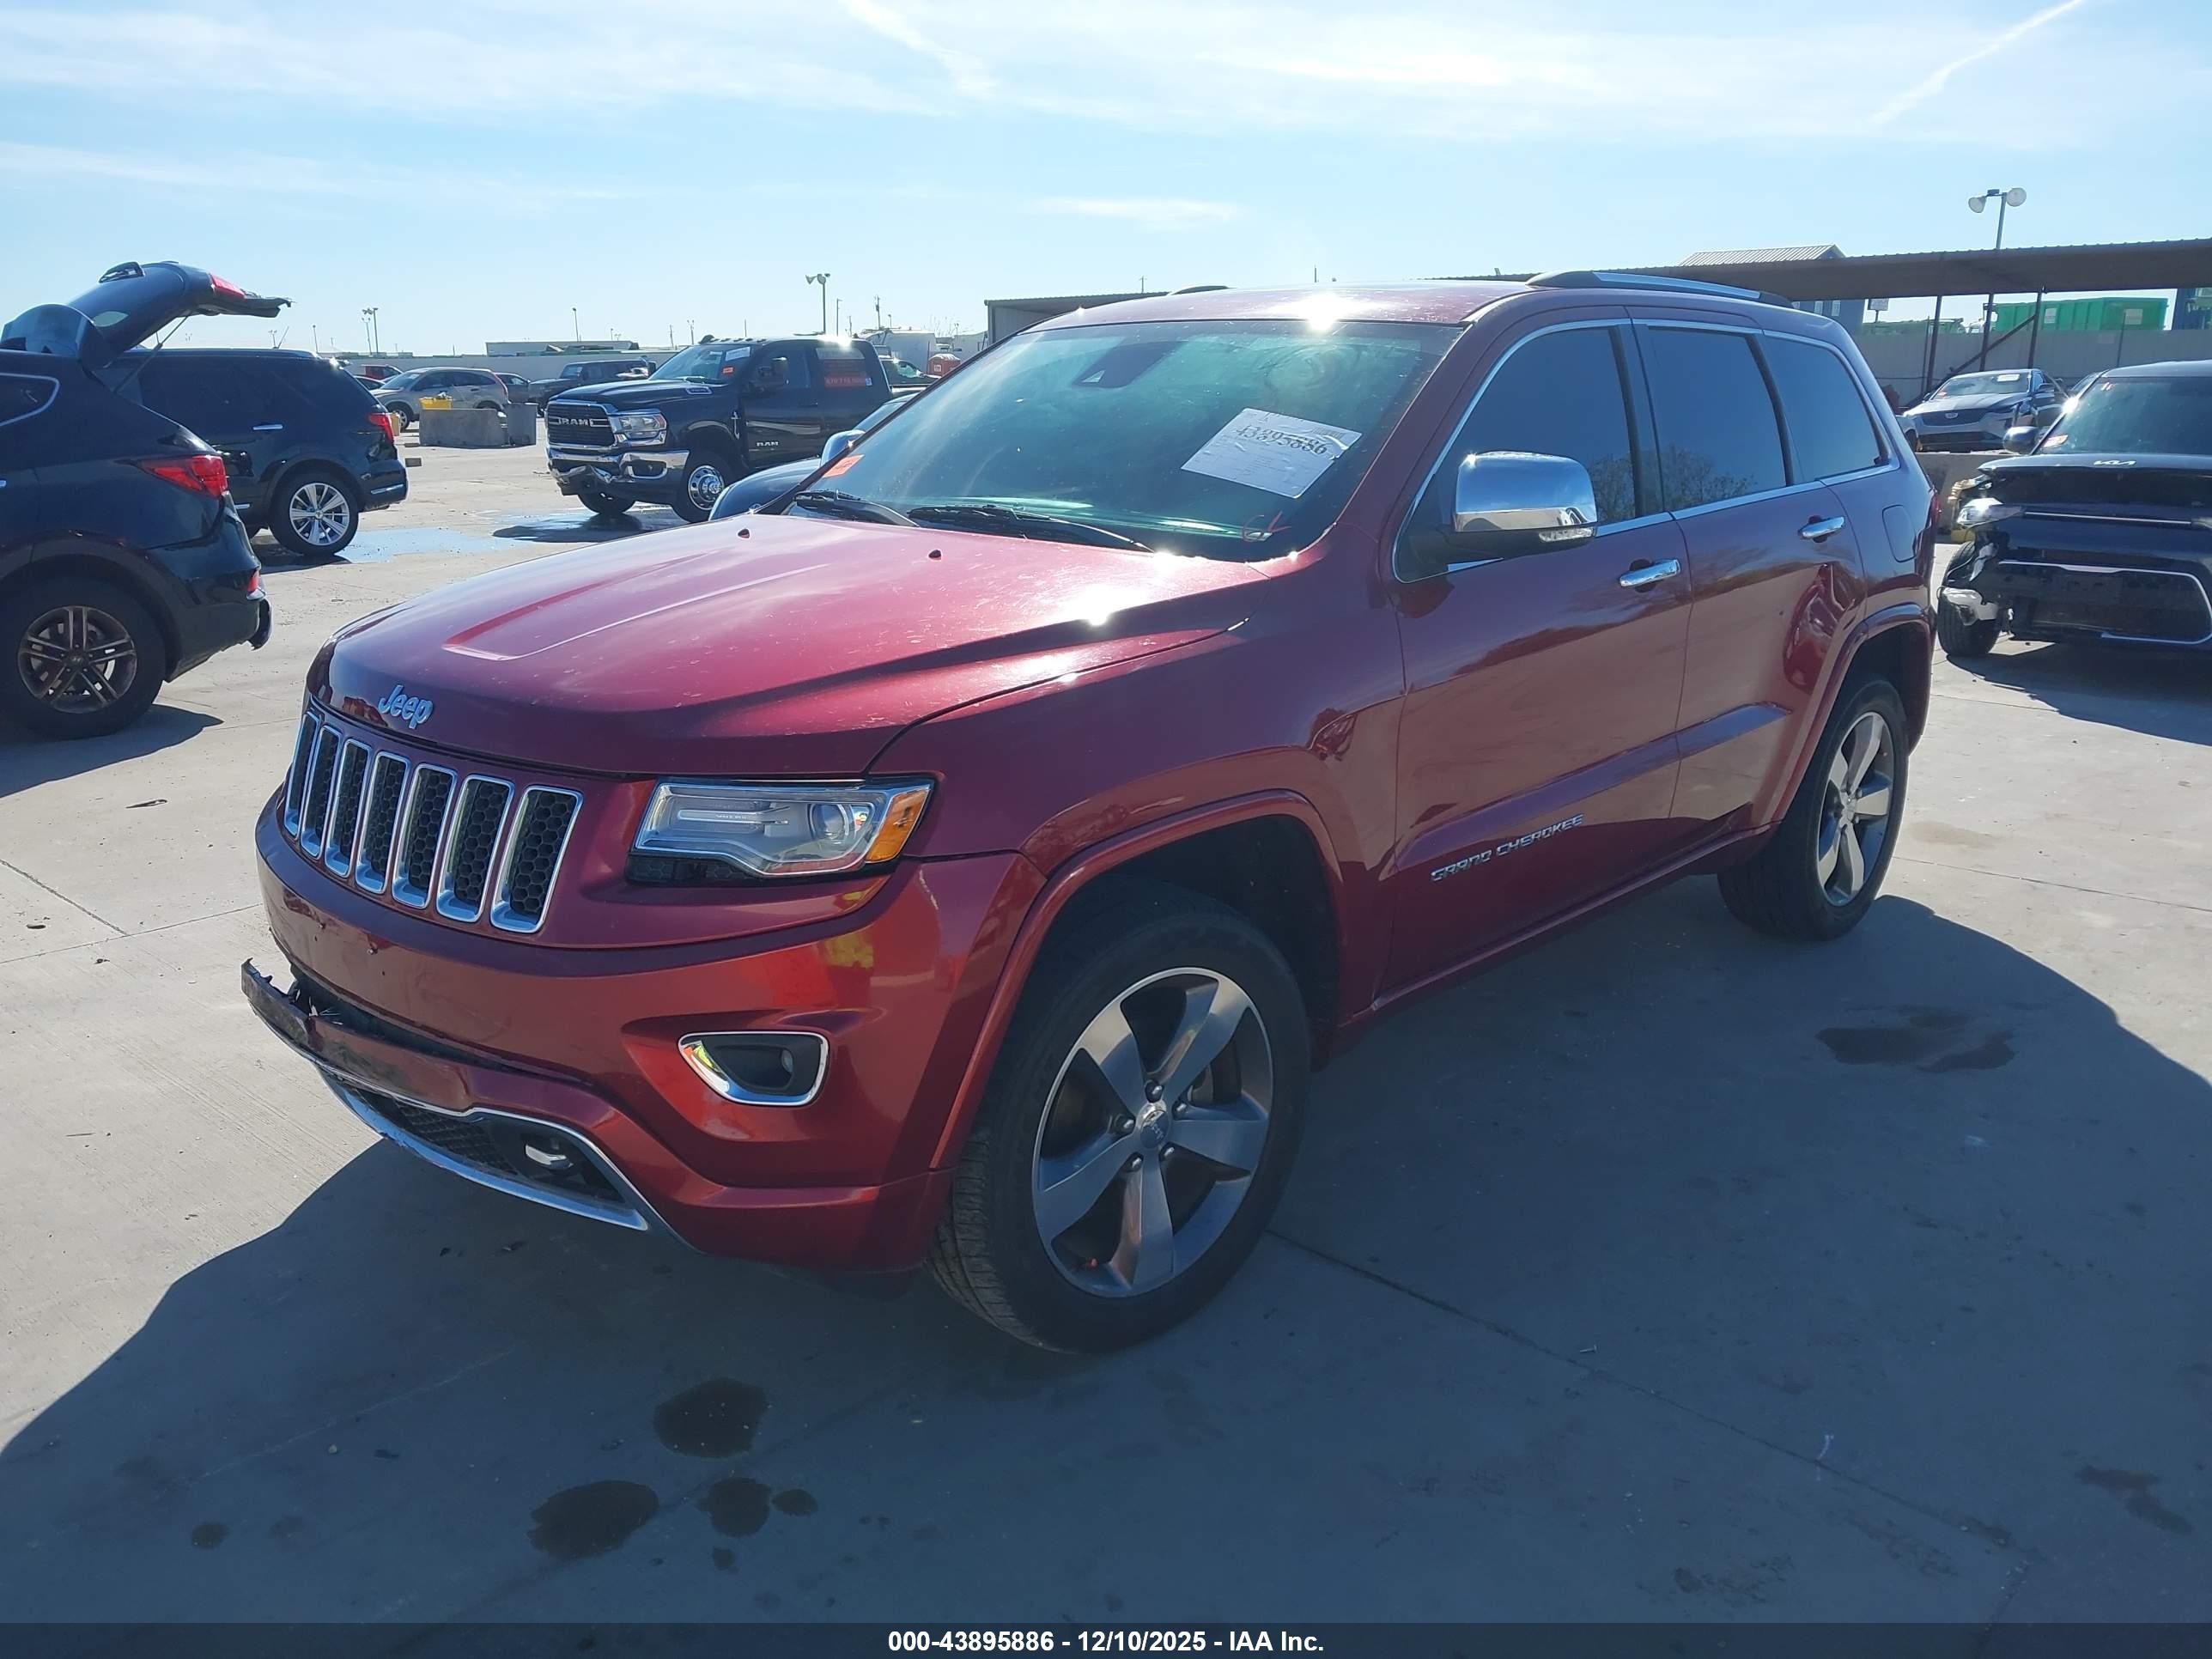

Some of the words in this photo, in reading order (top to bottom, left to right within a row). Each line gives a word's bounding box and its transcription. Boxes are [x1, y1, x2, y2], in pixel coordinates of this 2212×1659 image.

[560, 416, 590, 427] RAM
[378, 684, 434, 730] Jeep
[1431, 849, 1492, 882] GRAND
[1496, 814, 1584, 857] CHEROKEE
